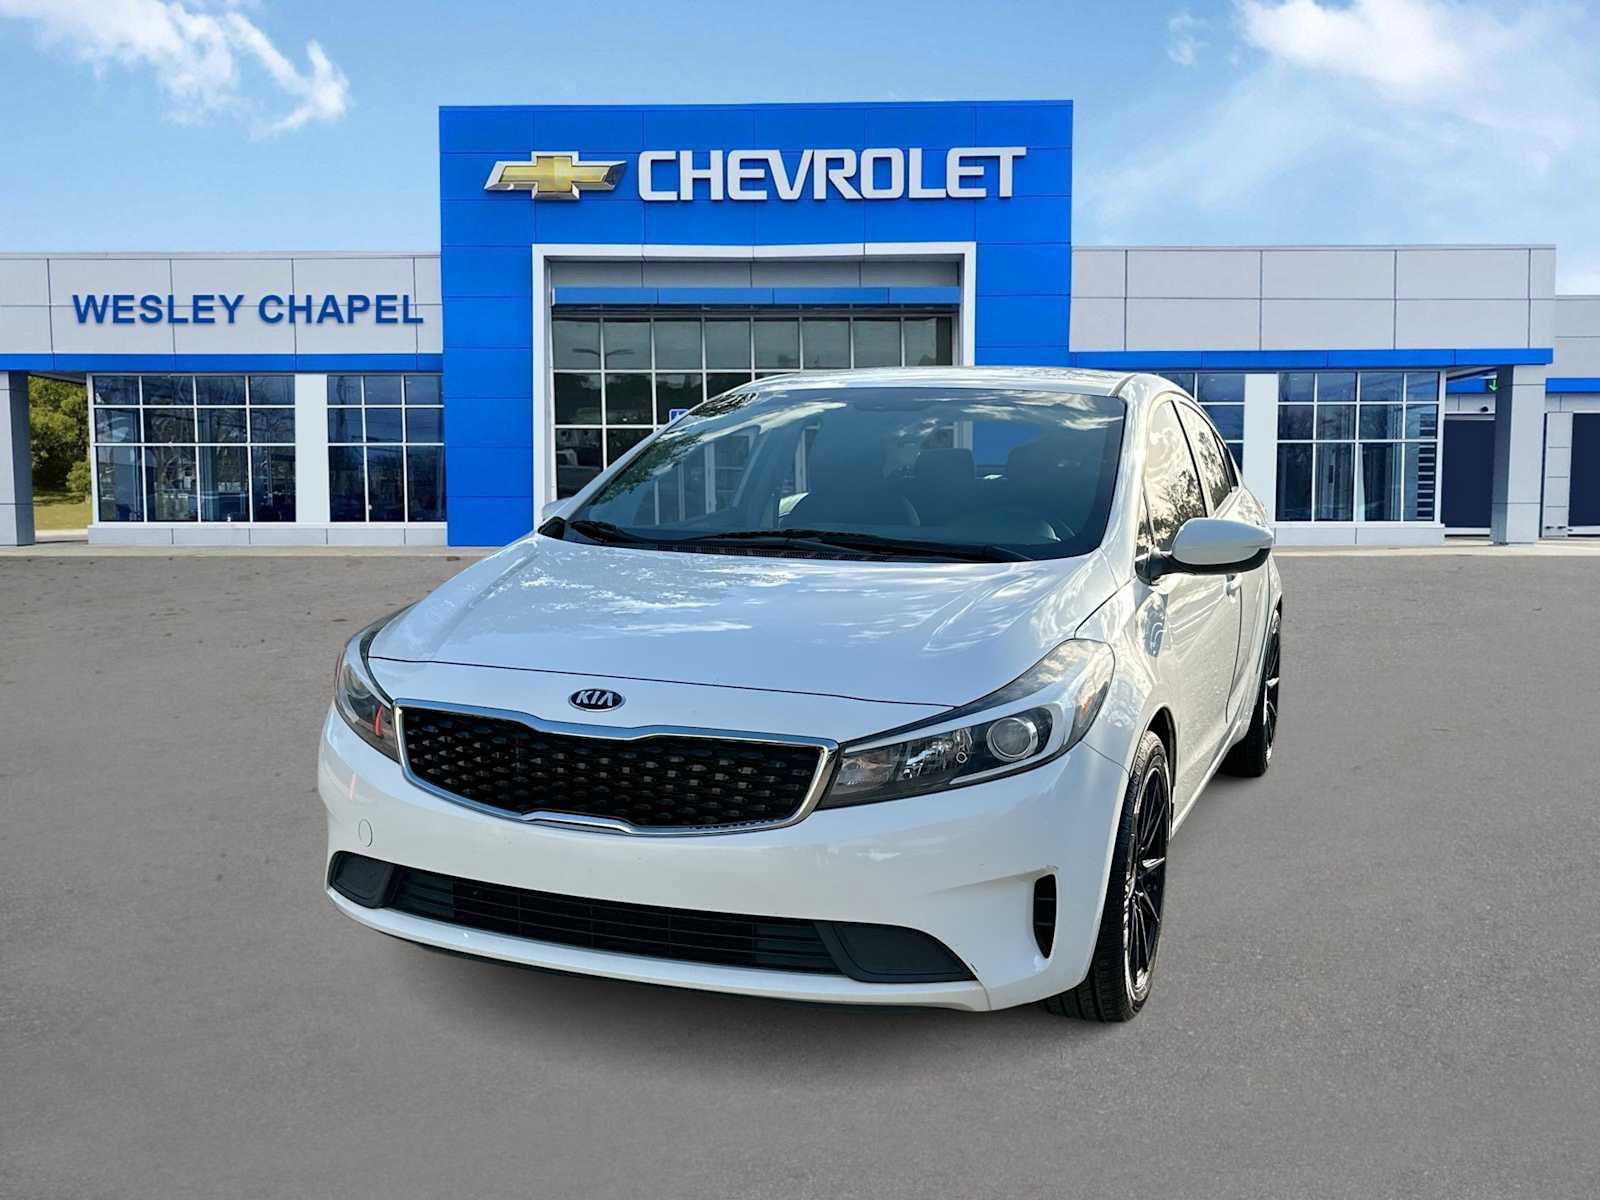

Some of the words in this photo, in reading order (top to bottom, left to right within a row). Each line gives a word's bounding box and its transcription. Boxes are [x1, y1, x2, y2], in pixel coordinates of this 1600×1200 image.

[637, 146, 1027, 202] CHEVROLET
[72, 294, 245, 325] WESLEY
[258, 294, 424, 325] CHAPEL
[575, 690, 614, 707] KIA
